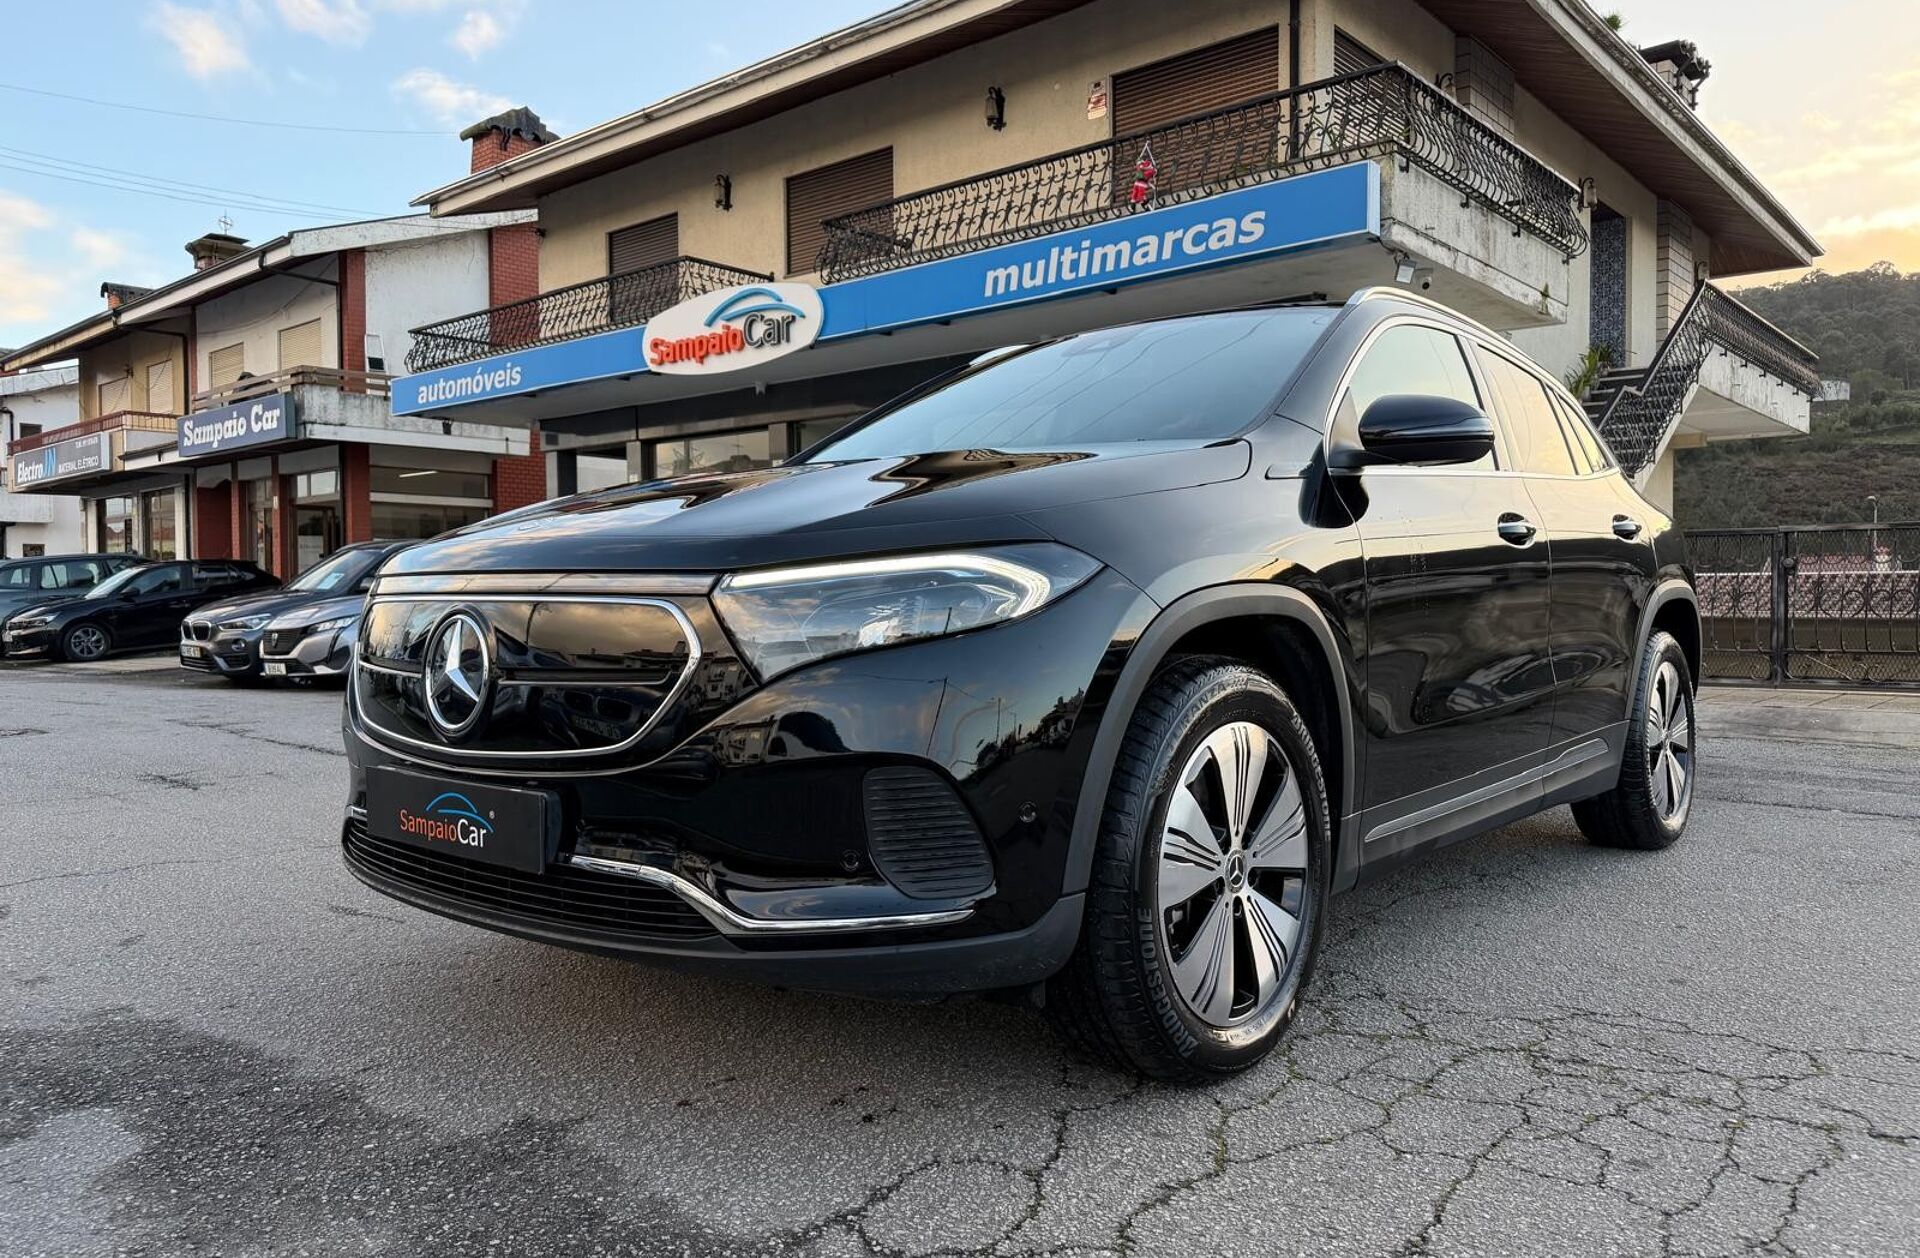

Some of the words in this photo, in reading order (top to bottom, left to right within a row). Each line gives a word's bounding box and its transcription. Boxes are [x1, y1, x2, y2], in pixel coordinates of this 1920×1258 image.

[984, 211, 1266, 298] multimarcas
[417, 362, 522, 404] automóveis
[183, 411, 247, 449] Sampaio
[251, 404, 280, 433] Car
[400, 809, 487, 848] SampaioCar
[1137, 908, 1199, 1059] BRIDGESTONE
